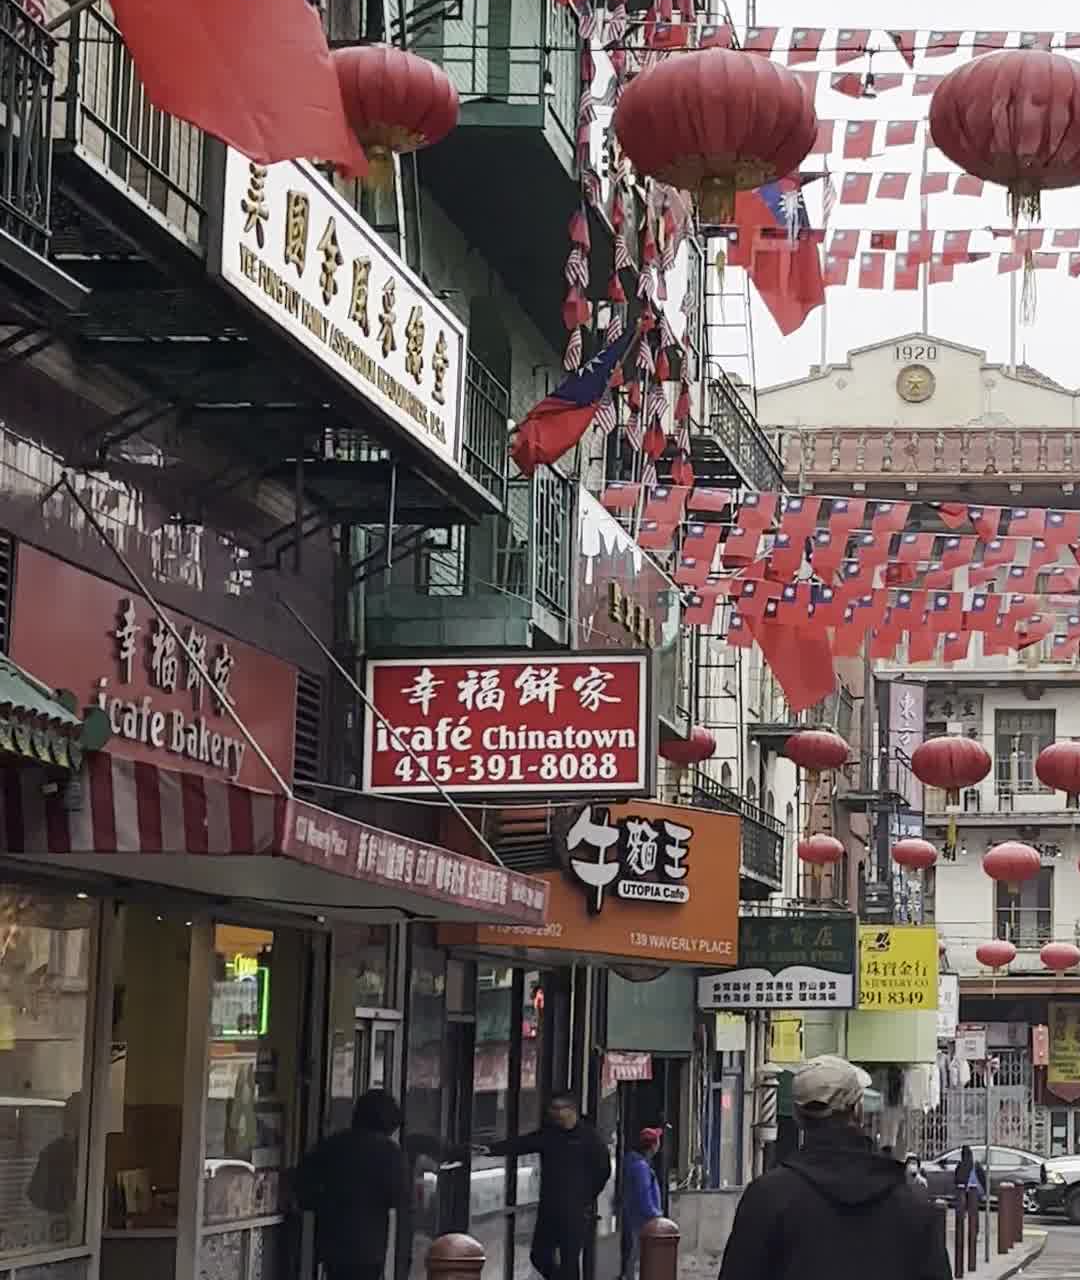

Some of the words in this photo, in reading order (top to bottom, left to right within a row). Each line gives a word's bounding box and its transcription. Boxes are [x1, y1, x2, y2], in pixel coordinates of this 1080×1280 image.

[258, 259, 283, 305] FUNG
[301, 298, 330, 345] FAMILY
[896, 346, 937, 361] 1920
[400, 666, 622, 716] 幸福餅家
[171, 707, 247, 783] Bakery
[375, 715, 474, 753] icafé
[481, 723, 637, 752] Chinatown
[393, 752, 619, 783] 415-391-8088
[622, 884, 661, 898] UTOPIA
[662, 886, 686, 900] Cafe
[630, 932, 648, 946] 139
[649, 934, 698, 952] WAVERLY
[699, 938, 732, 954] PLACE
[887, 991, 924, 1005] 8349
